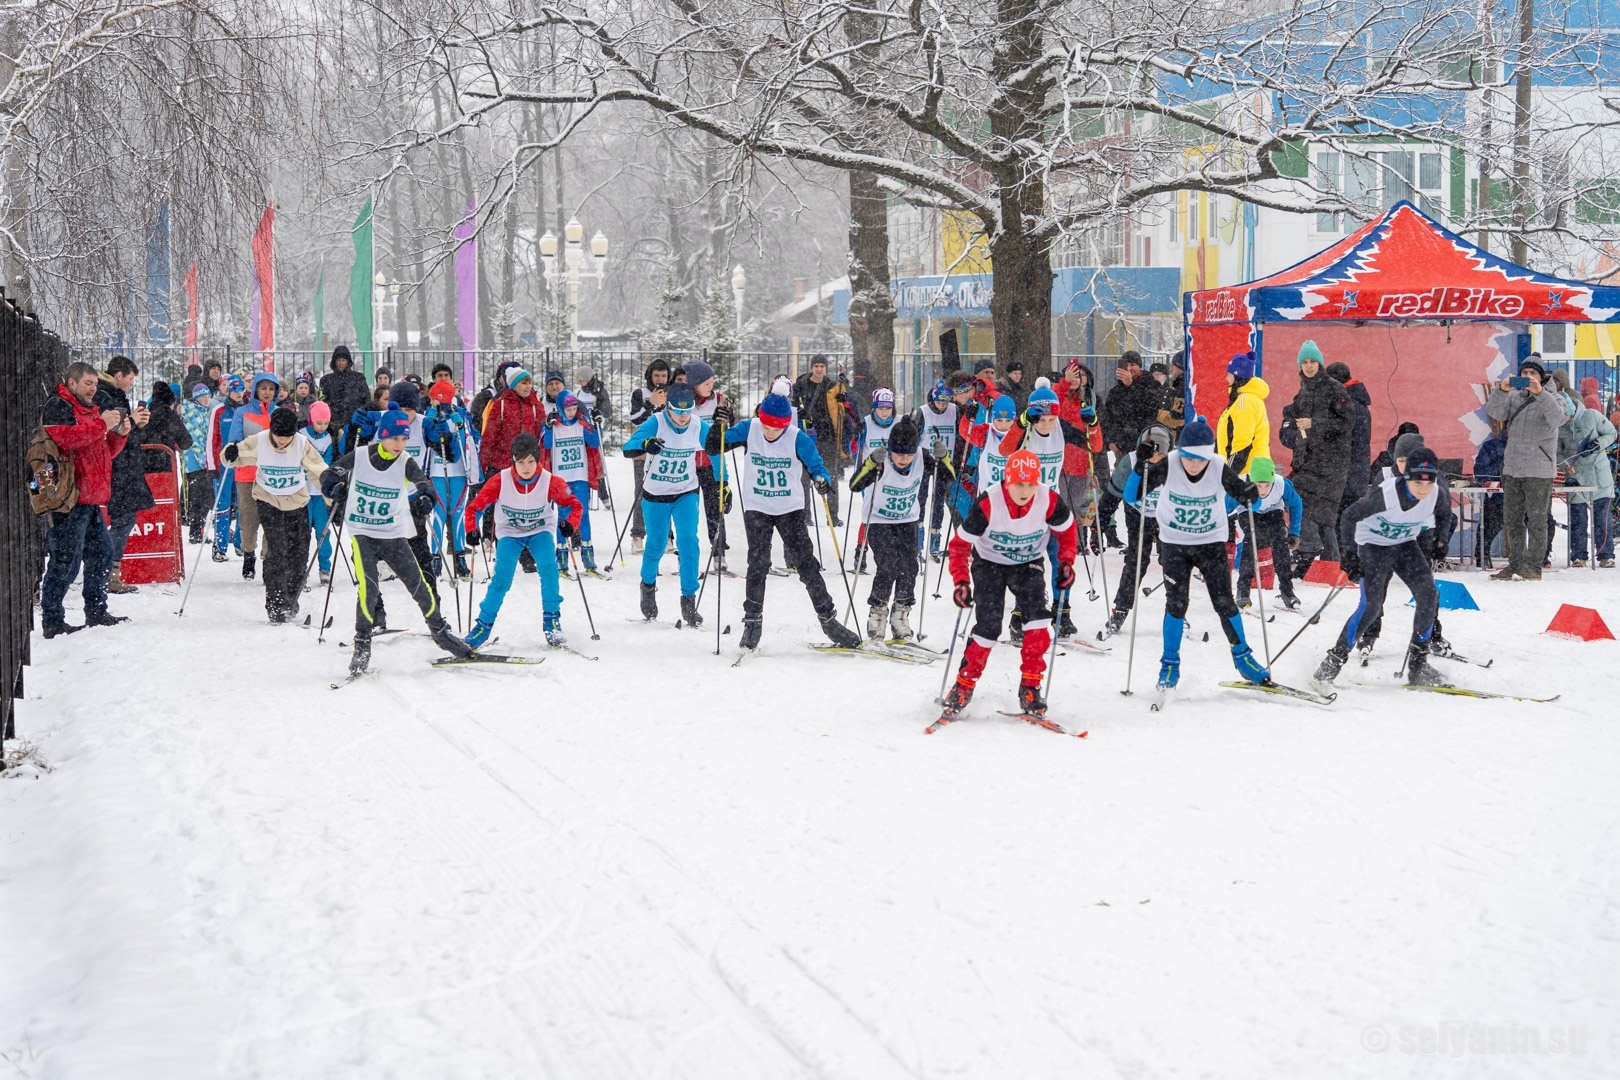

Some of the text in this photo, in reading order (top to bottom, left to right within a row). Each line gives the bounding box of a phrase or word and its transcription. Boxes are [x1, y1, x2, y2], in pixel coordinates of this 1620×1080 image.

[1205, 290, 1236, 322] redBike
[1377, 286, 1525, 317] redBike
[1011, 455, 1038, 474] DNB
[756, 468, 788, 489] 318
[1041, 466, 1057, 485] 14
[1174, 507, 1212, 526] 323
[129, 521, 166, 537] АРТ
